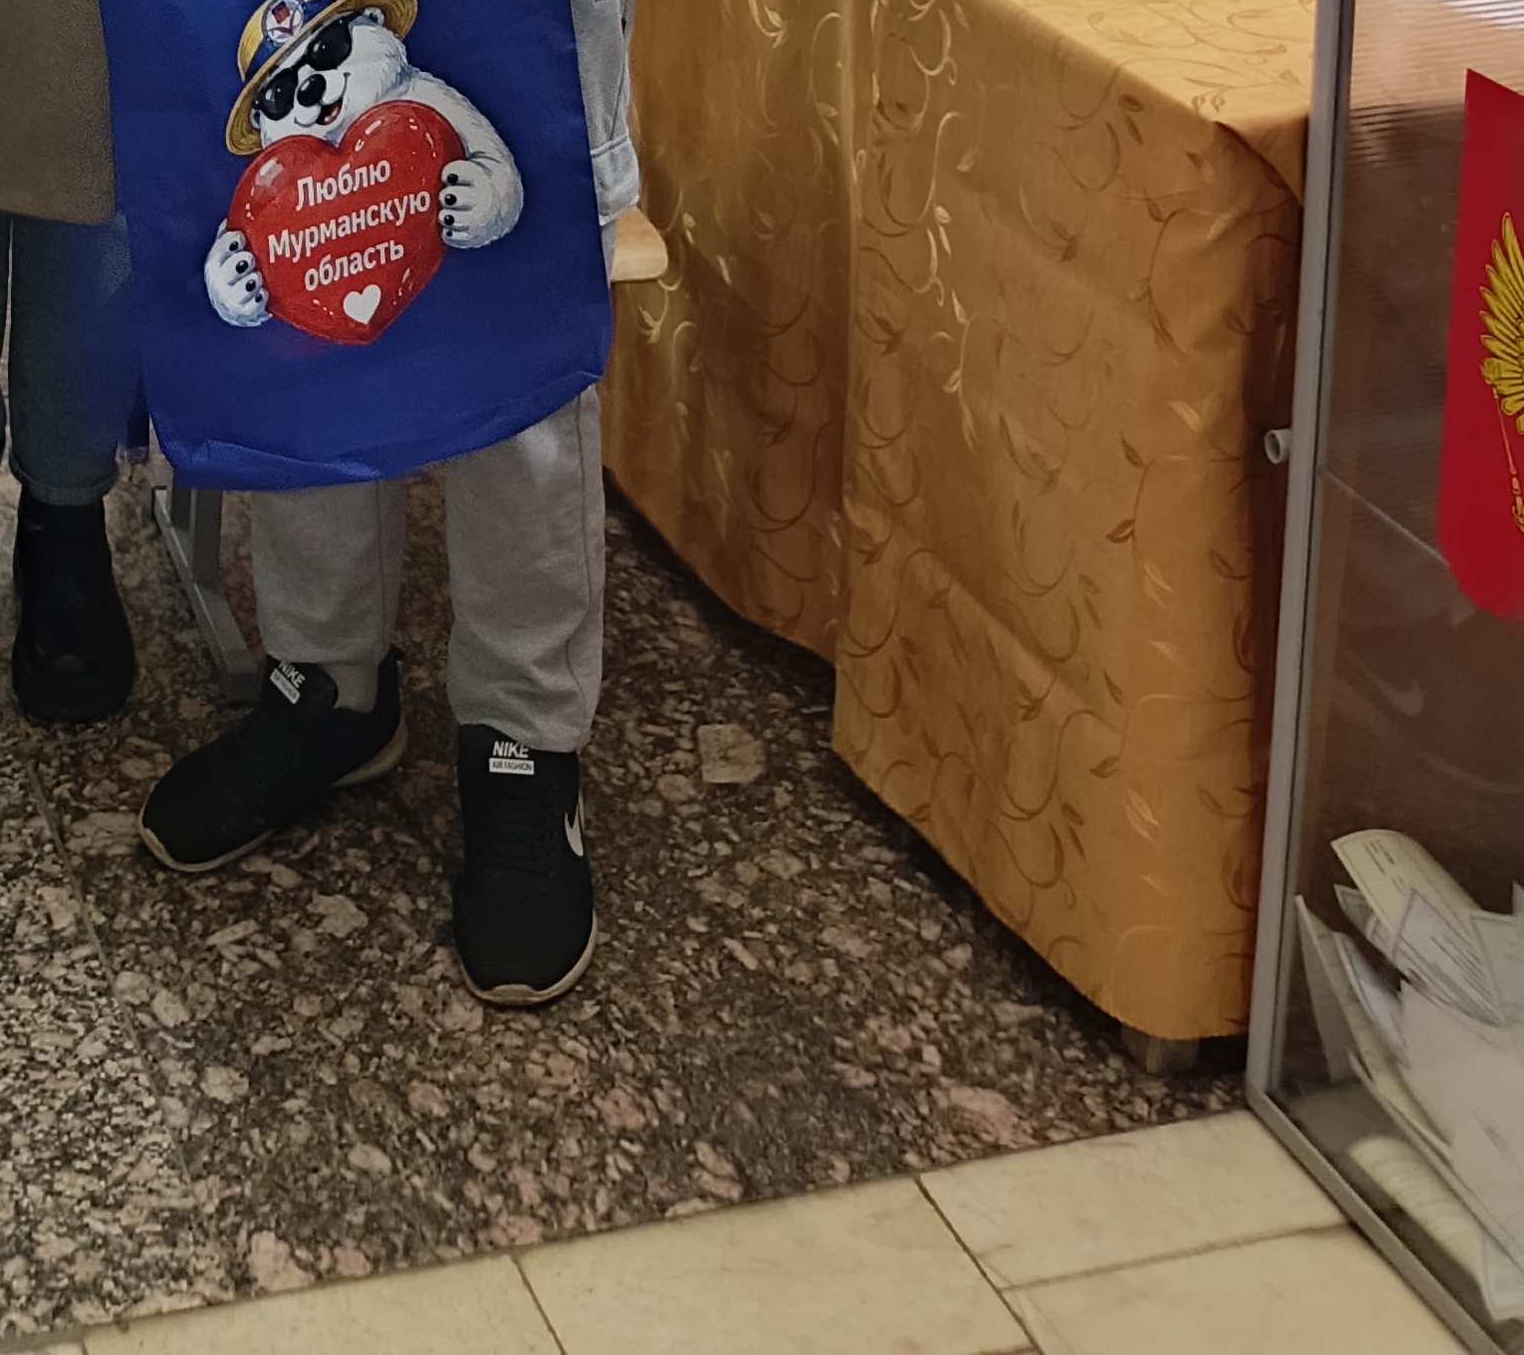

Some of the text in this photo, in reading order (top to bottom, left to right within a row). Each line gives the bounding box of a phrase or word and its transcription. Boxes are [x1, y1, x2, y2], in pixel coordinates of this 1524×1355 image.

[296, 160, 391, 211] Люблю
[267, 191, 431, 264] Мурманскую
[304, 239, 405, 291] область
[278, 660, 306, 689] NIKE
[492, 741, 529, 759] NIKE
